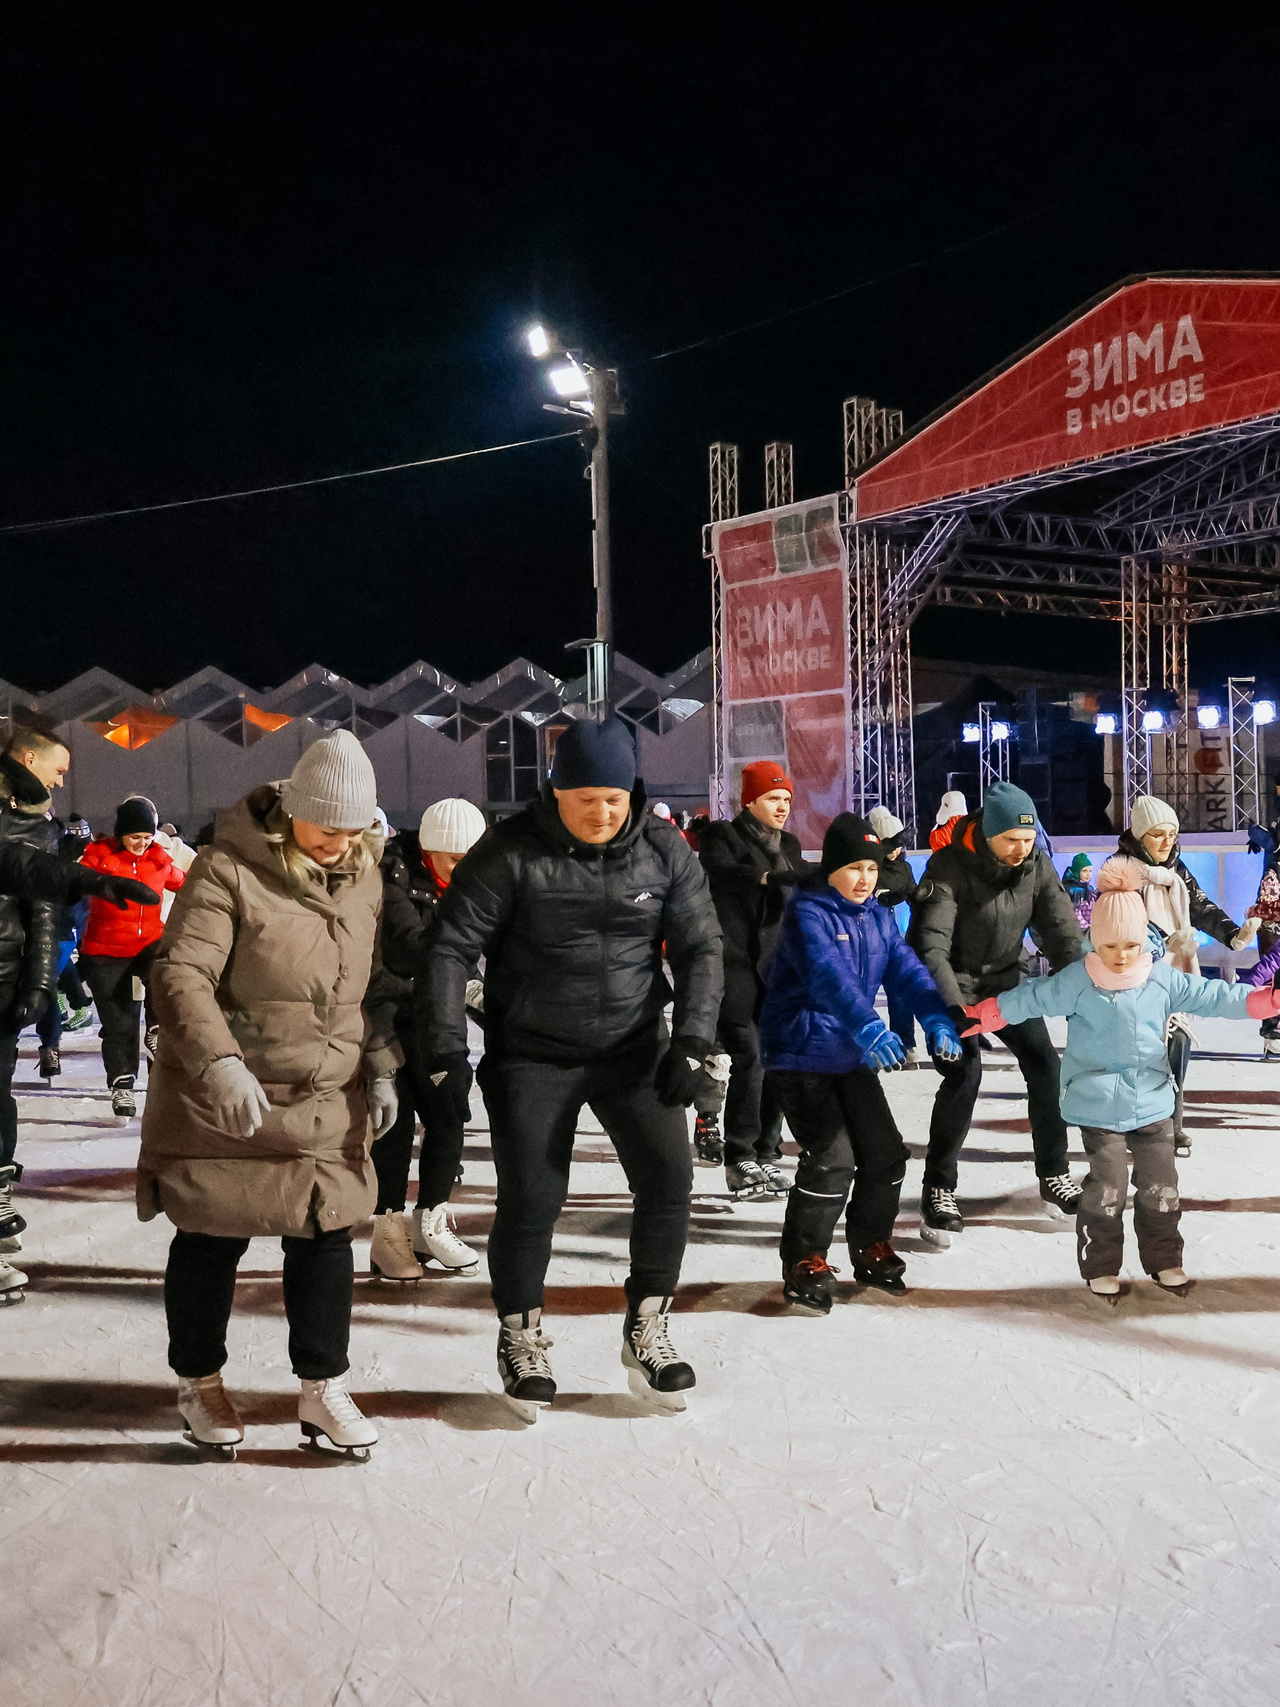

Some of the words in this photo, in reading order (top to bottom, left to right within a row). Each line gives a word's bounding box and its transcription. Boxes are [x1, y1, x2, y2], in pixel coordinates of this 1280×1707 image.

[1065, 314, 1204, 398] ЗИМА
[1066, 408, 1083, 435] В
[1091, 373, 1205, 429] МОСКВЕ
[738, 594, 830, 648] ЗИМА
[753, 645, 831, 677] МОСКВЕ
